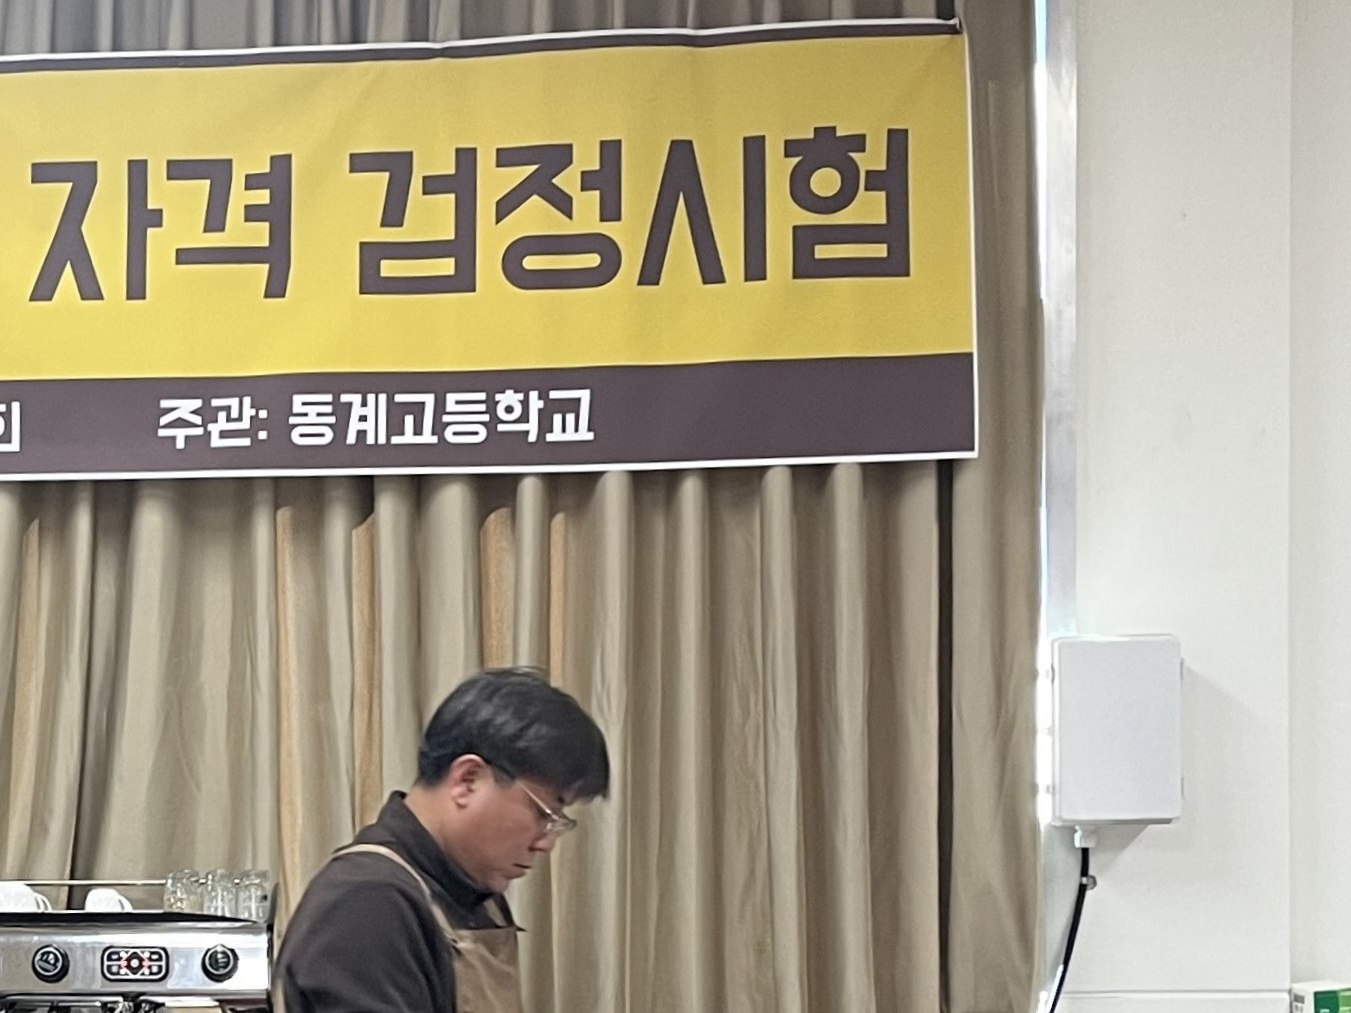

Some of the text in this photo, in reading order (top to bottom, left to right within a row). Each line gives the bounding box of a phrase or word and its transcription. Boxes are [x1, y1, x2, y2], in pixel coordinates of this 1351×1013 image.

[28, 152, 294, 303] 자격
[347, 124, 913, 296] 검정시험
[156, 388, 596, 450] 주관: 동계고등학교
